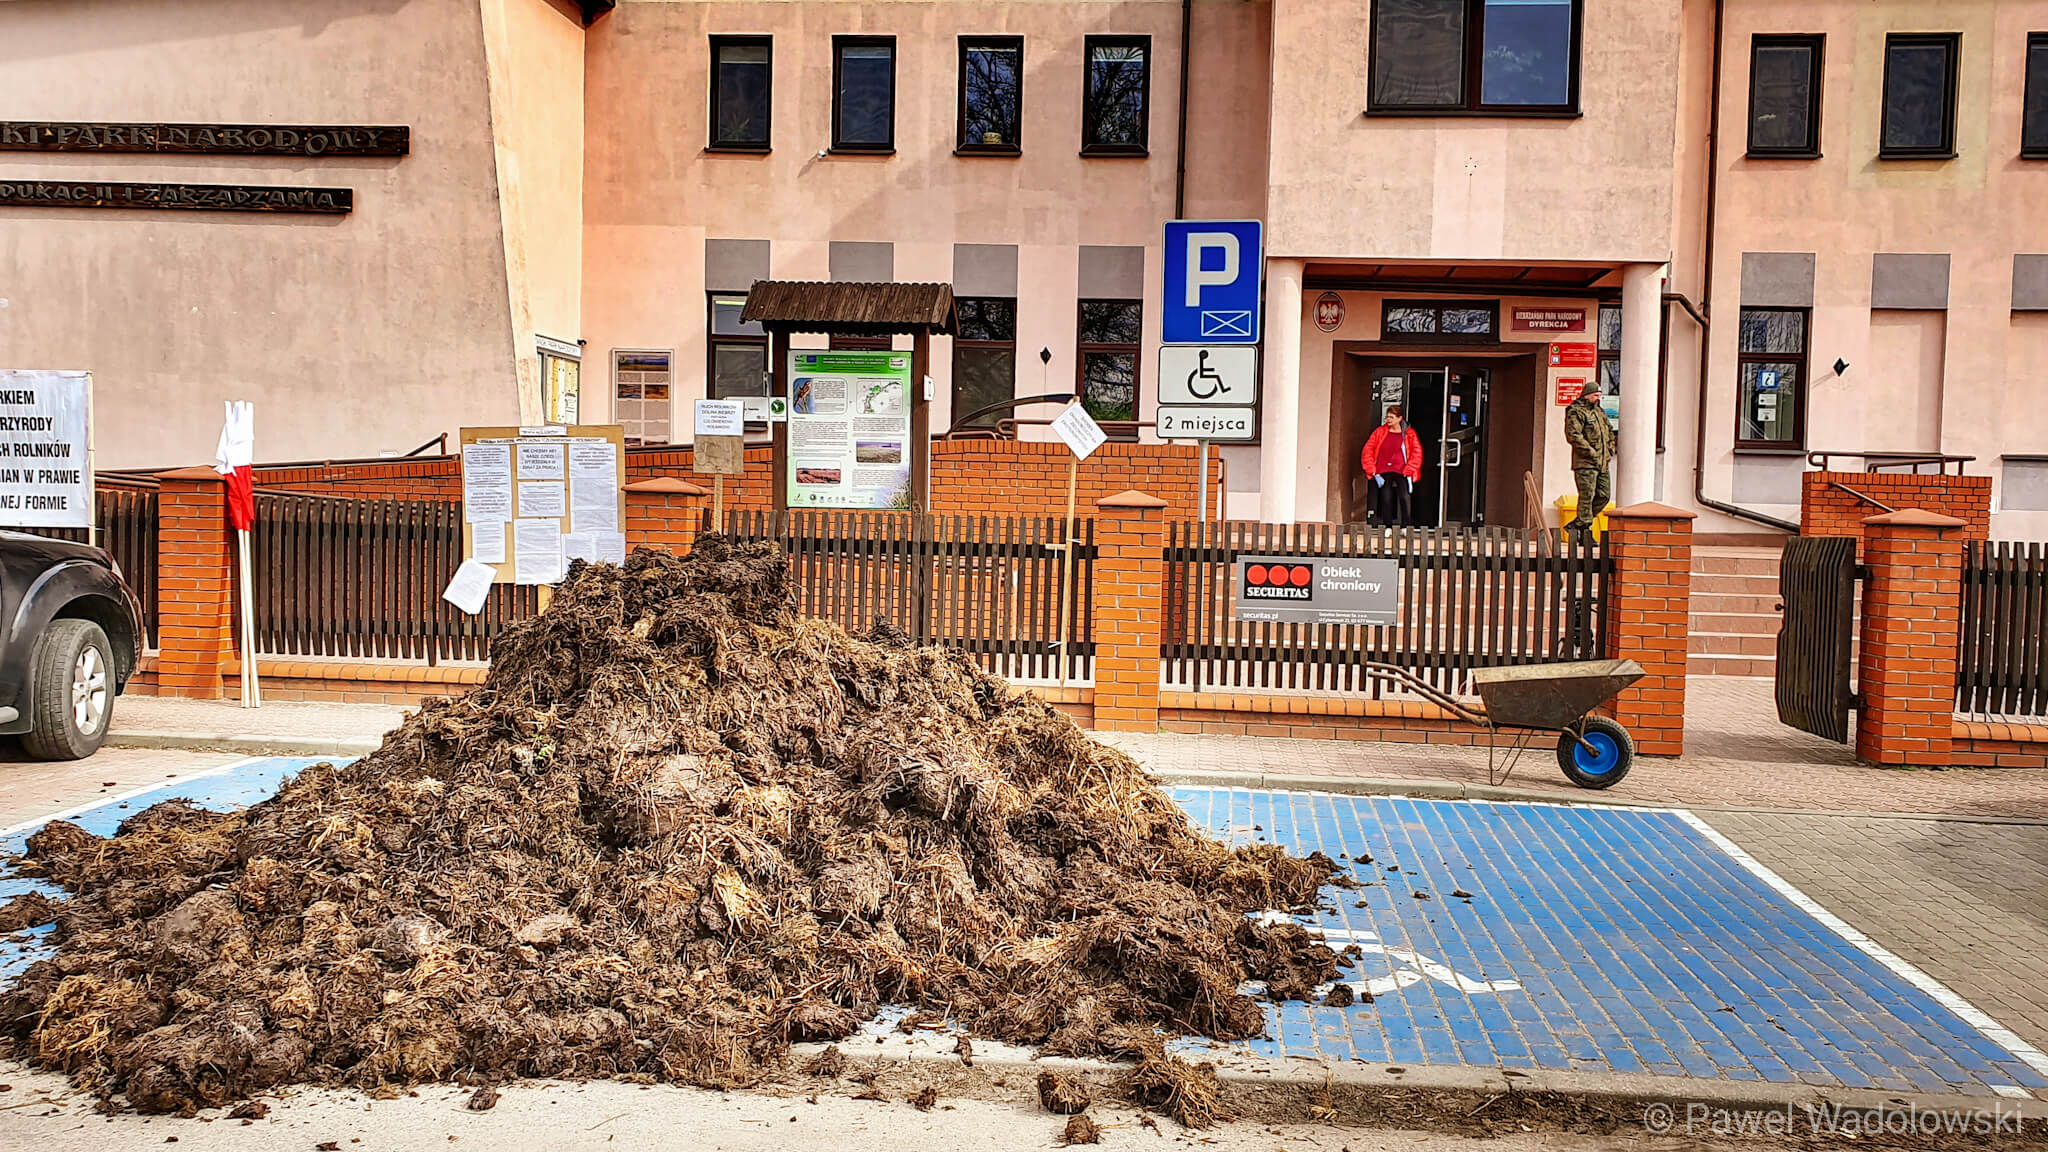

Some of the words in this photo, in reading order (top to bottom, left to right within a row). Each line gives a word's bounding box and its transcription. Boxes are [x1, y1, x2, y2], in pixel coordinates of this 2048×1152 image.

[57, 126, 153, 145] PARK
[169, 127, 384, 155] NARODOWY
[0, 184, 113, 200] DUKACJI
[1185, 232, 1240, 307] P
[1529, 320, 1568, 328] DYREKCJA
[1164, 416, 1174, 430] 2
[1181, 416, 1246, 434] miejsca
[14, 440, 71, 458] ROLNIKÓW
[23, 469, 34, 484] W
[38, 470, 80, 484] PRAWIE
[1, 495, 20, 509] NEJ
[25, 496, 68, 510] FORMIE
[1320, 566, 1362, 578] Obiekt
[1247, 587, 1310, 599] SECURITAS
[1320, 579, 1381, 593] chroniony
[1243, 612, 1279, 620] securitas.pl
